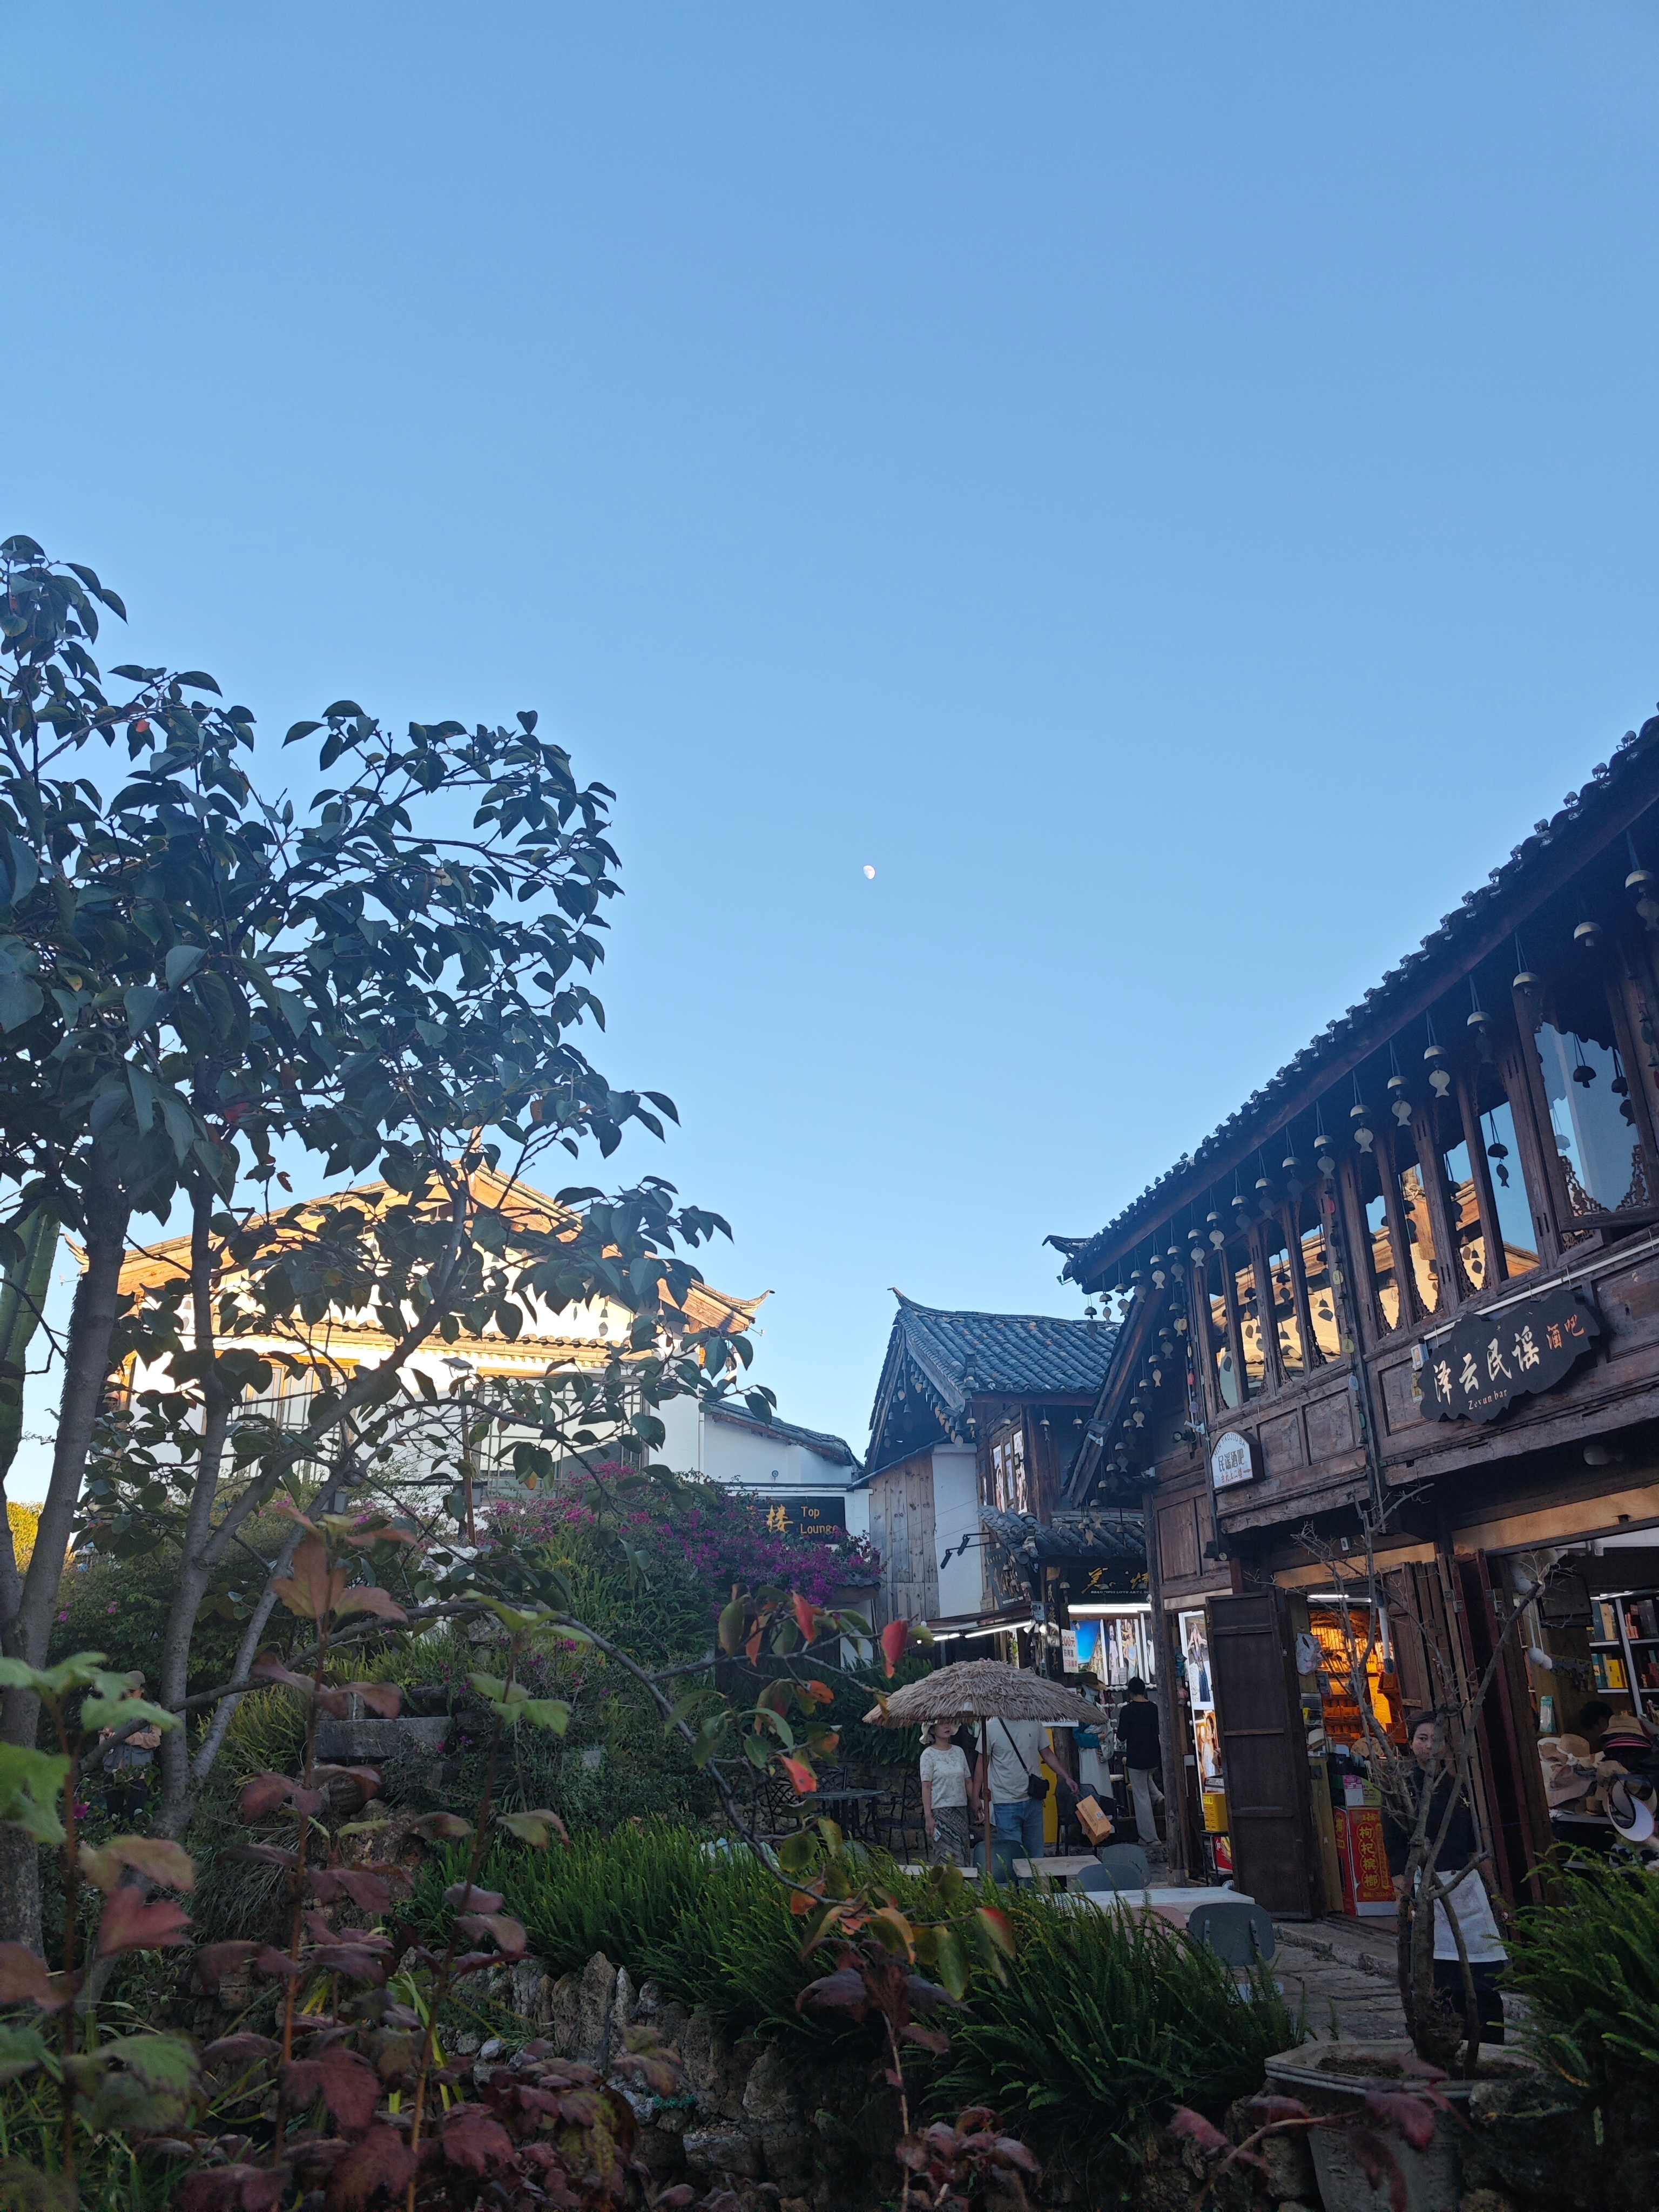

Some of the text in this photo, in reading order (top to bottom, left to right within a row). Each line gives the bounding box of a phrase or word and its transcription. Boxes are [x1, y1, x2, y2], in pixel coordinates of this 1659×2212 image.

[1433, 1313, 1586, 1406] 泽云民谣 酒吧
[1493, 1389, 1508, 1400] bar
[1218, 1448, 1245, 1473] 民谣酒吧
[800, 1506, 820, 1520] Top
[1359, 1826, 1378, 1887] 枸杞槟榔
